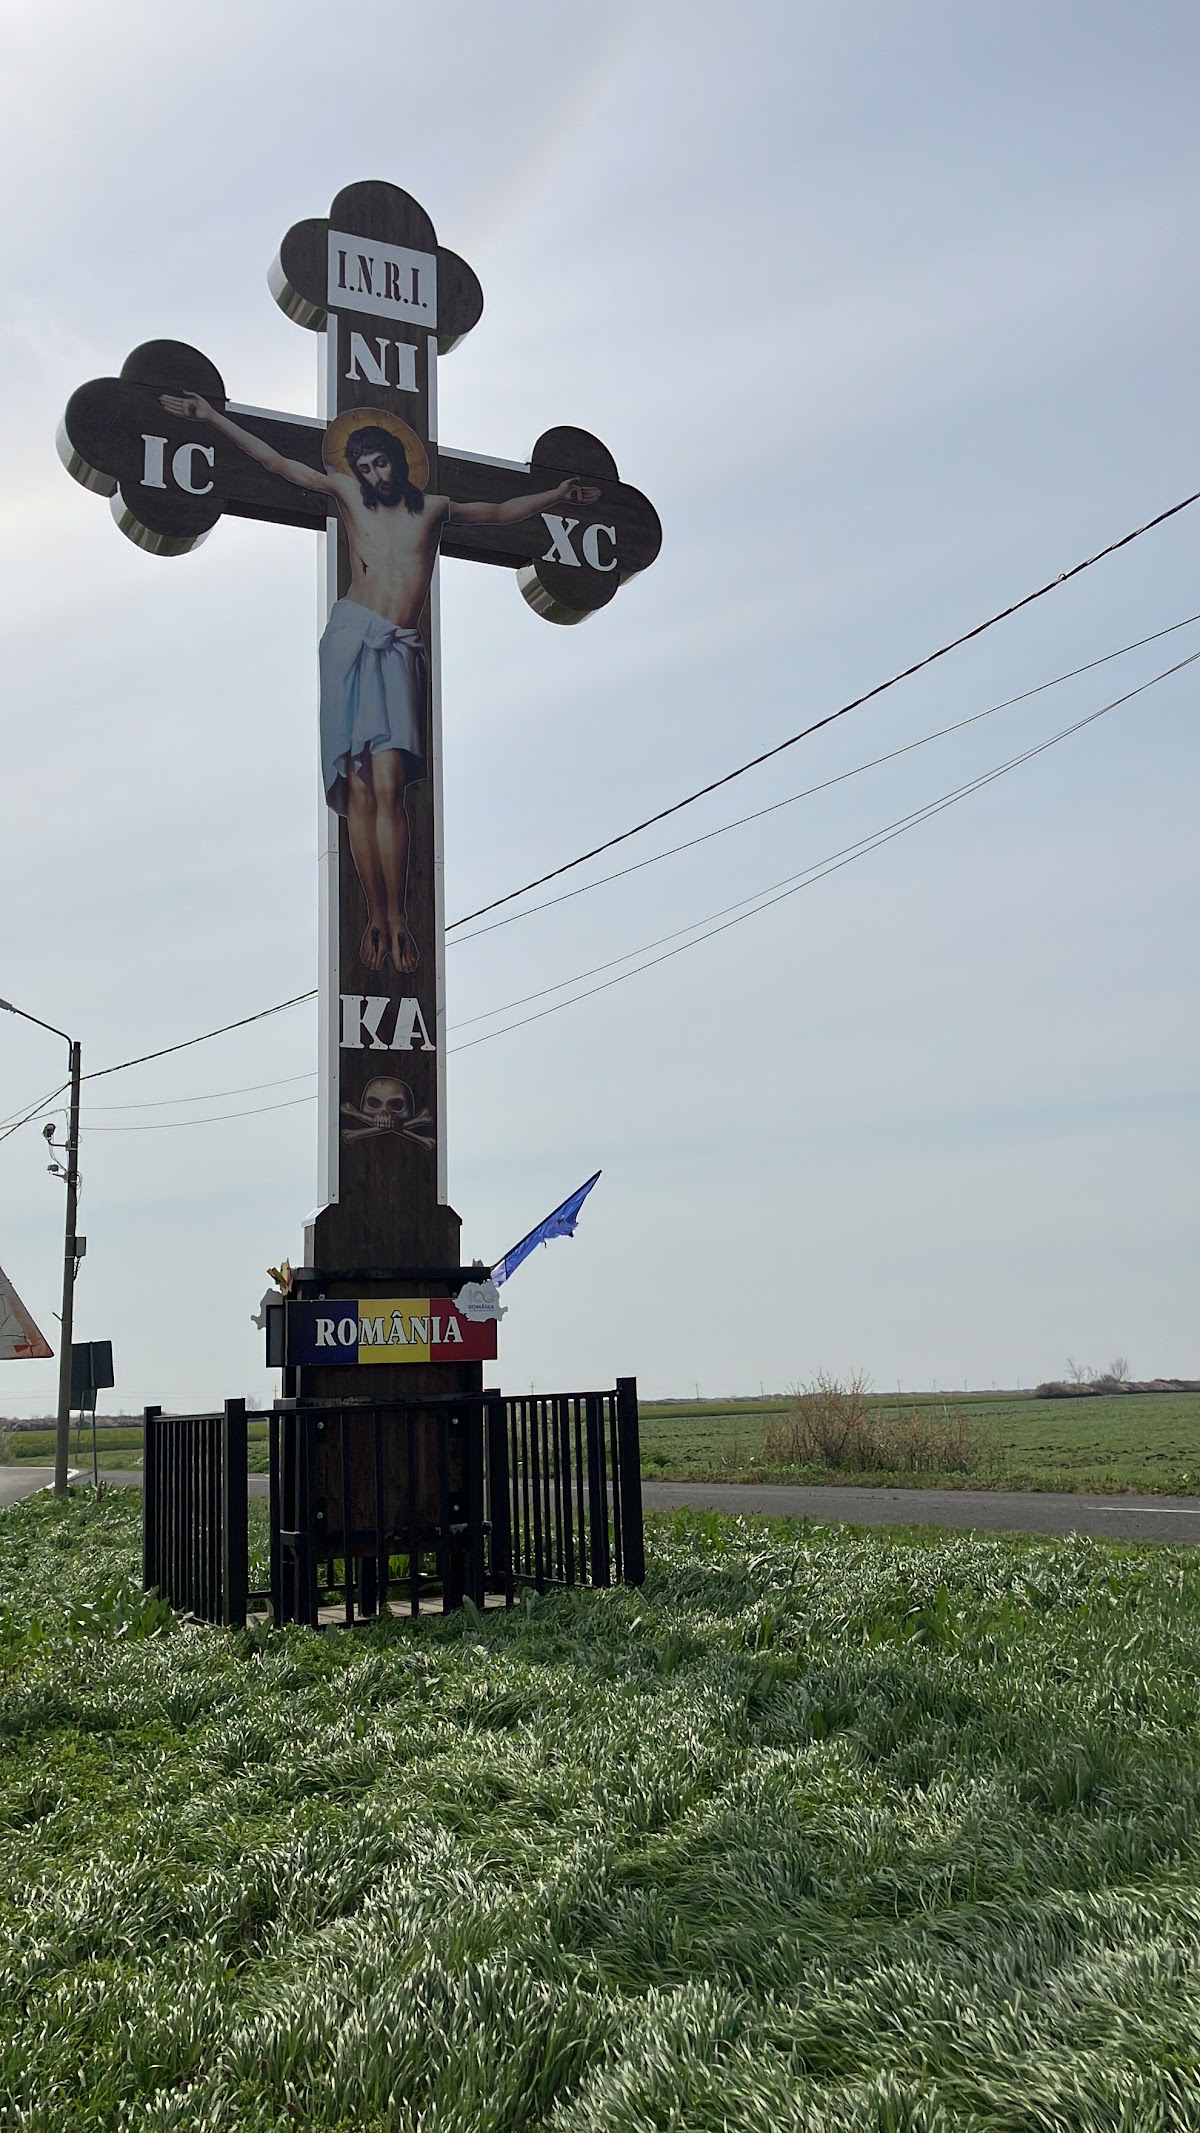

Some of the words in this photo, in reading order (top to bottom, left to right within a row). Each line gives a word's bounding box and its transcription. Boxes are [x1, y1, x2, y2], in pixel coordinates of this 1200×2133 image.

[338, 250, 427, 308] I.N.R.I.
[345, 332, 419, 392] NI
[140, 434, 214, 495] IC
[541, 513, 617, 571] XC
[339, 994, 436, 1051] KA
[315, 1310, 463, 1346] ROMÂNIA
